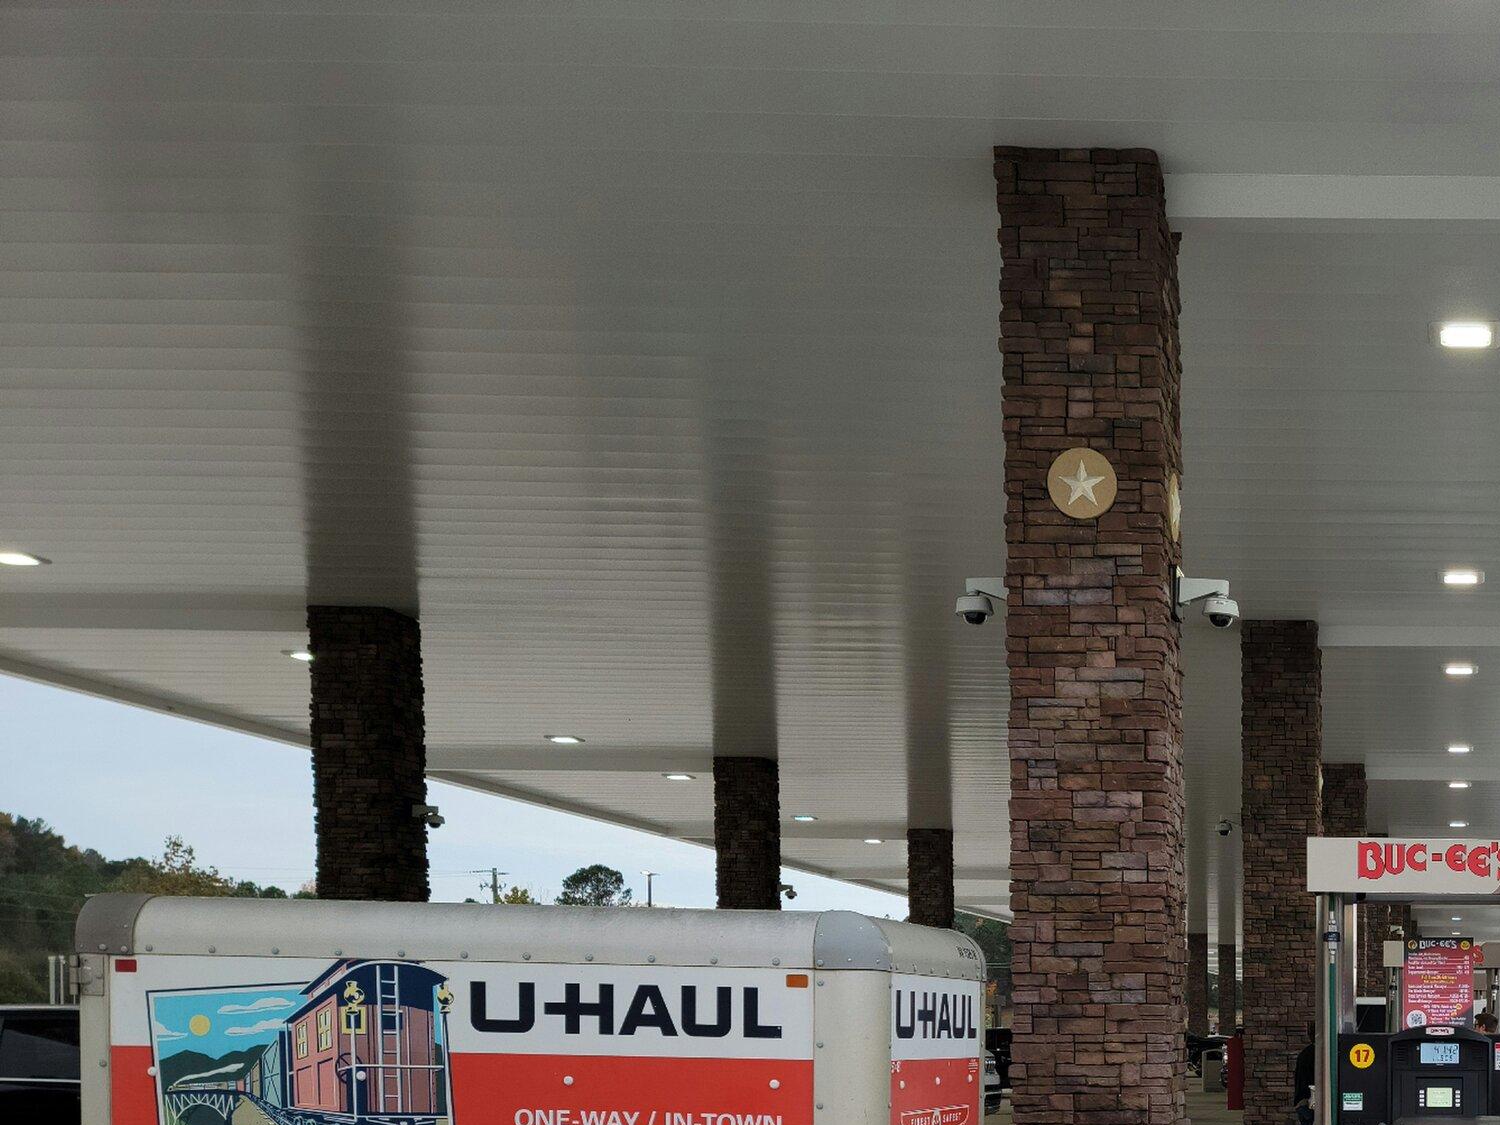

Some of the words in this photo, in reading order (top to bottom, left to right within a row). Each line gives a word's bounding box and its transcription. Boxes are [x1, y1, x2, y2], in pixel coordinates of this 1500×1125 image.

[470, 981, 782, 1039] U-HAUL
[896, 989, 977, 1039] U-HAUL
[1354, 1049, 1370, 1063] 17
